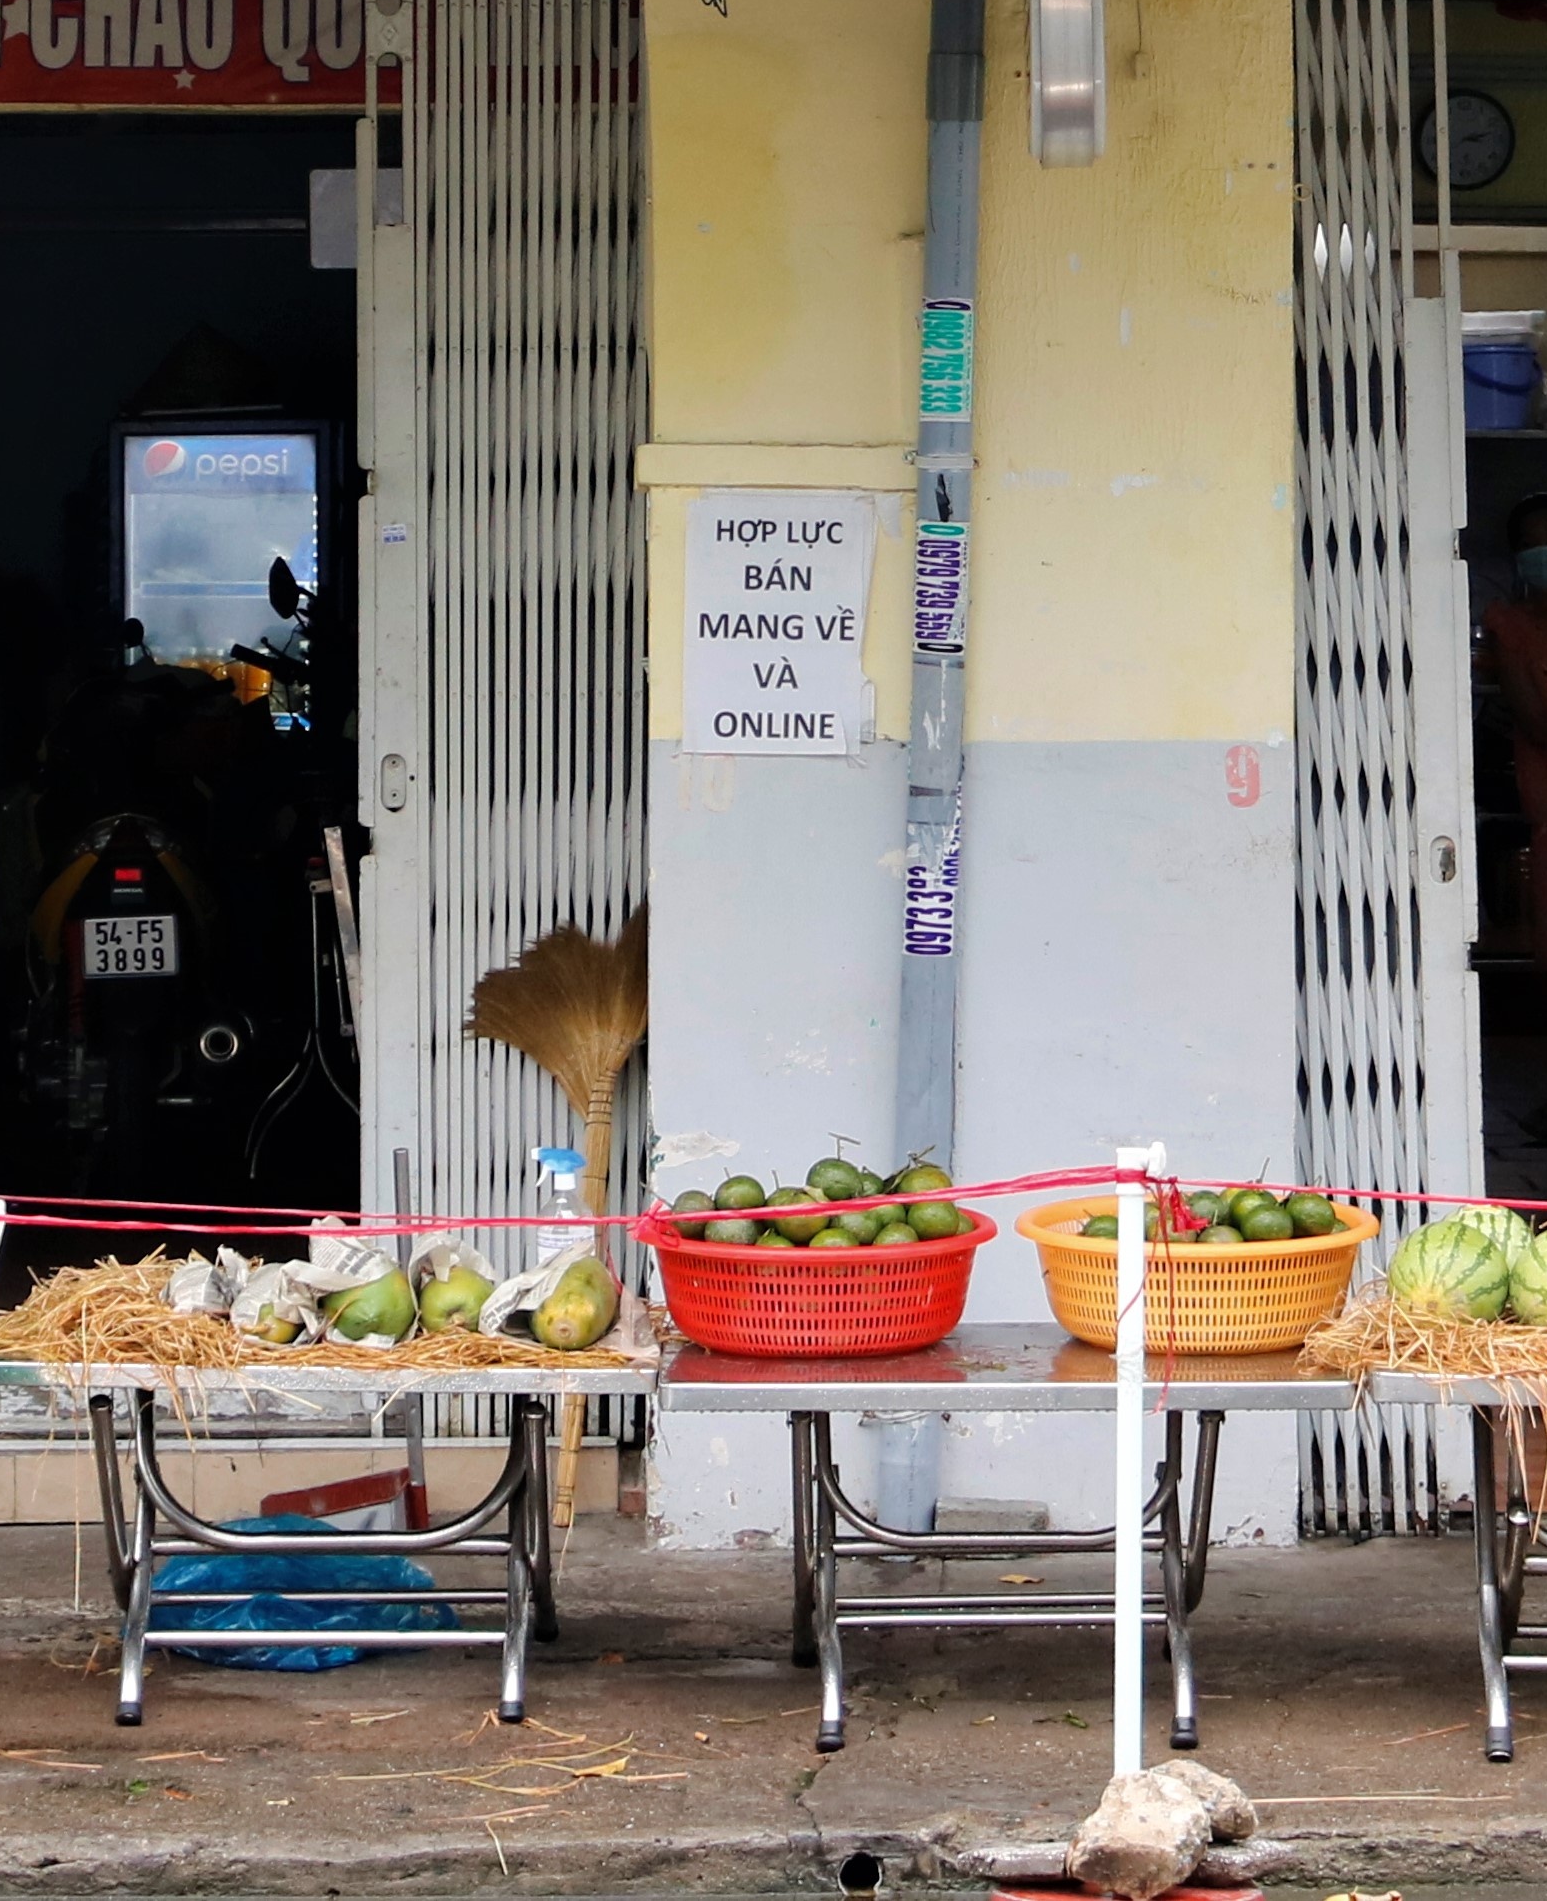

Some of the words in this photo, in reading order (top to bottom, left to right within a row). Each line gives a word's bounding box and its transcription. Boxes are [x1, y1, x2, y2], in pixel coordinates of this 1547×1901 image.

[922, 312, 965, 350] 0982
[921, 354, 964, 381] 756
[920, 385, 962, 413] 333
[196, 449, 289, 482] pepsi
[716, 519, 777, 548] HỢP
[787, 520, 843, 549] LỰC
[744, 558, 812, 591] BÁN
[698, 613, 804, 640] MANG
[815, 605, 855, 641] VỀ
[753, 656, 798, 689] VÀ
[713, 711, 835, 739] ONLINE
[1225, 745, 1260, 808] 9
[95, 919, 164, 946] 54-F5
[96, 947, 165, 972] 3899
